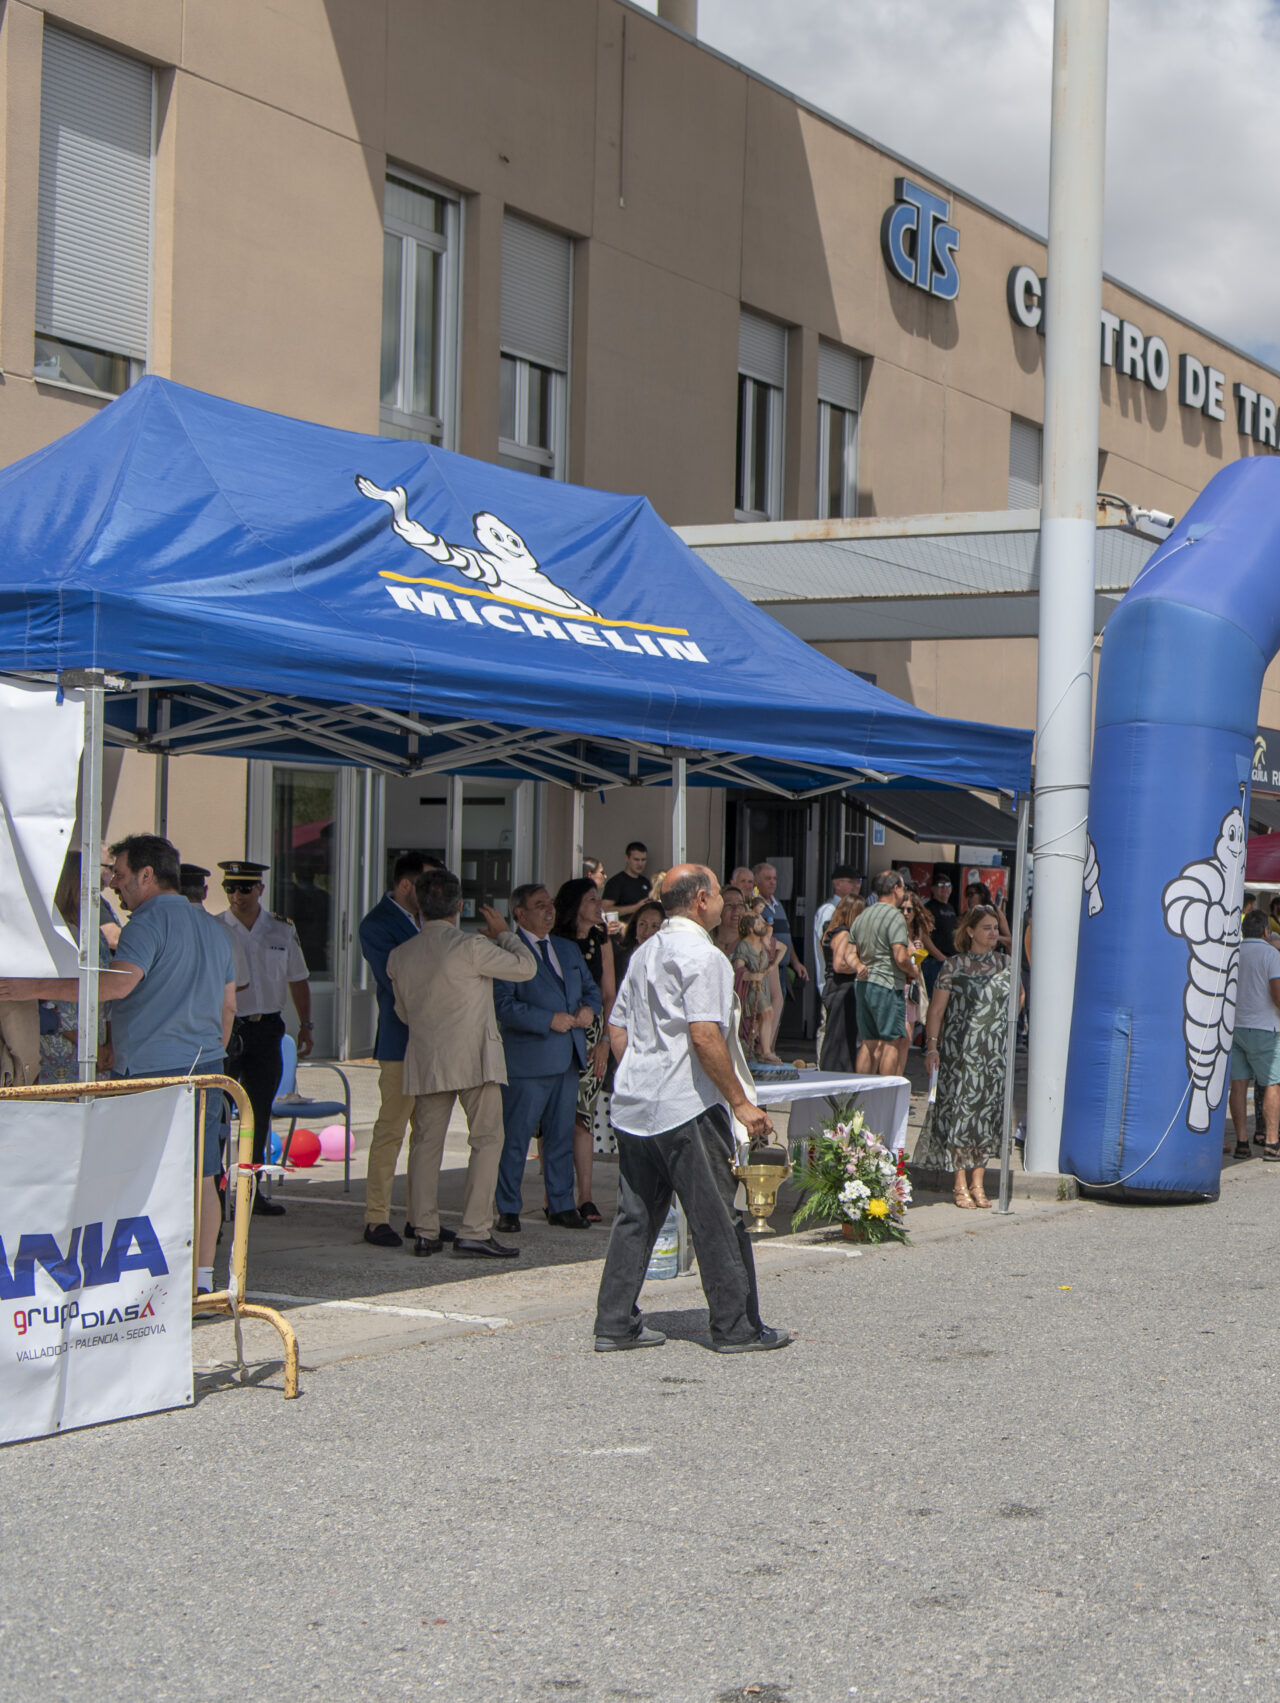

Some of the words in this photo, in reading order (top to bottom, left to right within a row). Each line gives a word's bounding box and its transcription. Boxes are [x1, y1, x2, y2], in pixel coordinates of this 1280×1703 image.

[882, 177, 960, 300] CTS
[1007, 265, 1170, 392] CTRO
[1179, 353, 1226, 422] DE
[385, 585, 710, 664] MICHELIN
[0, 1215, 169, 1300] NIA
[13, 1301, 80, 1335] grupo
[81, 1300, 155, 1330] DIASA
[75, 1333, 119, 1350] PALENCIA
[126, 1323, 166, 1340] SEGOVIA
